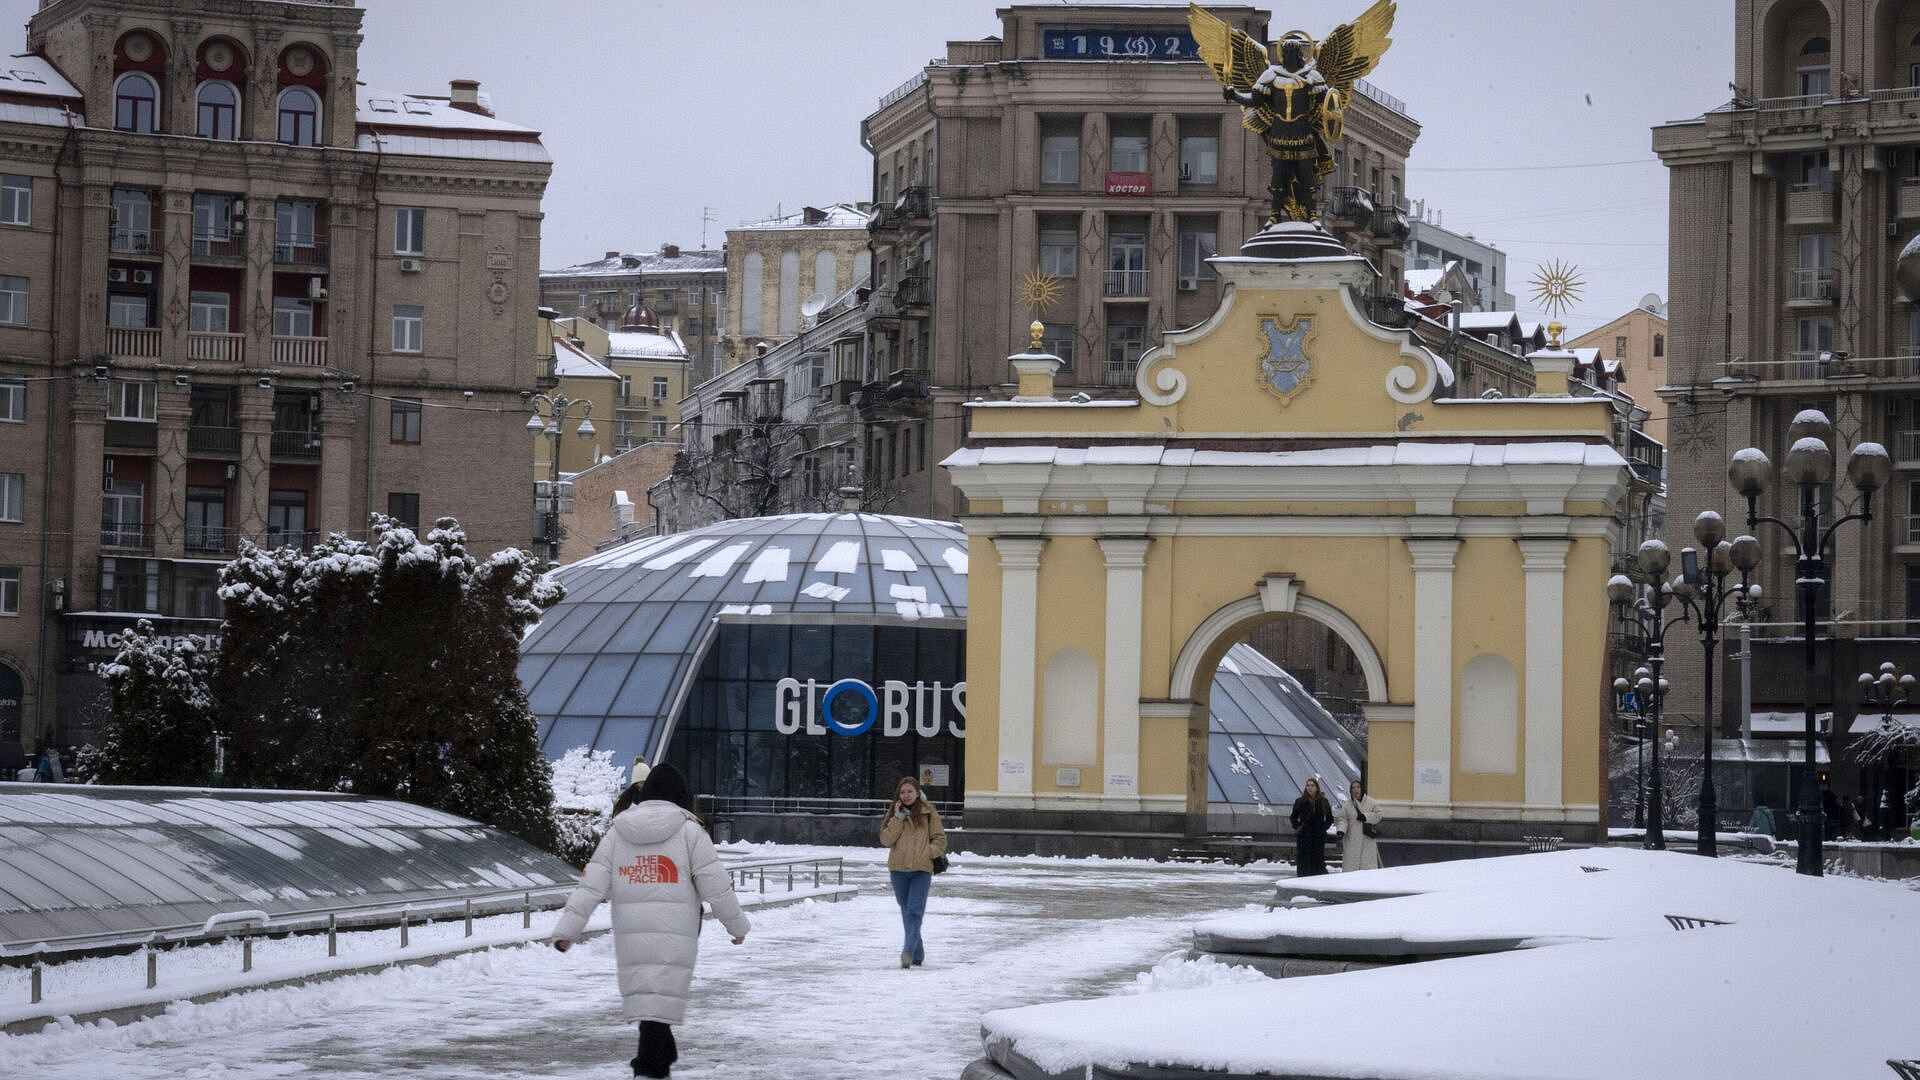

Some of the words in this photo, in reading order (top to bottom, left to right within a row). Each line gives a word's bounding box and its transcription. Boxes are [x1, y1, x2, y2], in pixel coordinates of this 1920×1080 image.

[1109, 185, 1146, 193] хостел
[775, 677, 966, 738] GLOBUS
[635, 855, 657, 864] THE
[619, 865, 657, 876] NORTH
[629, 874, 657, 884] FACE
